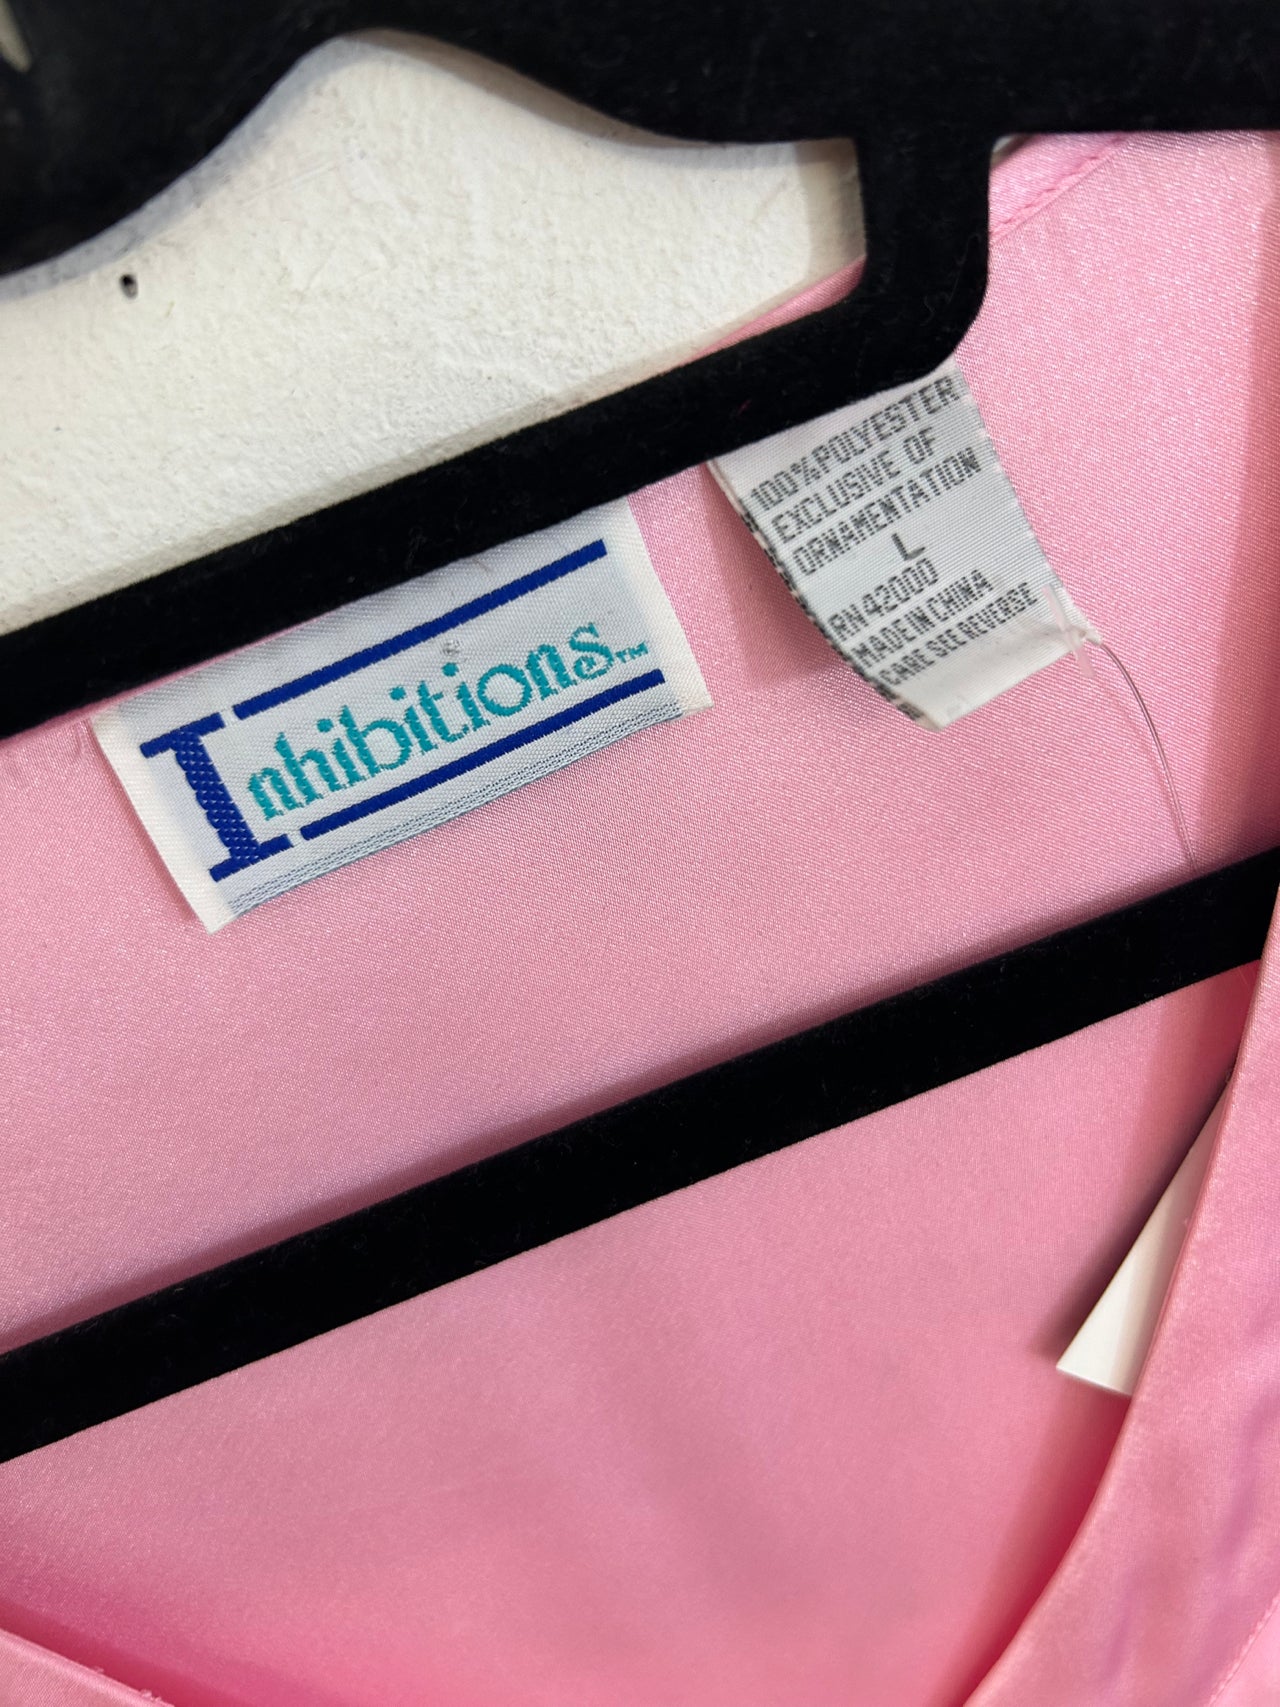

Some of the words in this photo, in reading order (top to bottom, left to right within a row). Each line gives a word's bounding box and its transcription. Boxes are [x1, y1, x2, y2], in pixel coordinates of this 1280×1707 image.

[771, 450, 901, 544] EXCLUSIVE
[902, 426, 936, 465] OF
[792, 447, 982, 576] ORNAMENTATION
[891, 532, 926, 562] L
[828, 603, 869, 642] RN
[861, 557, 939, 617] 42000
[851, 618, 916, 669] MADE
[904, 606, 936, 635] IN
[926, 569, 994, 622] CHINA
[878, 648, 935, 685] CARE
[925, 629, 967, 659] SEE
[956, 582, 1038, 640] REVERSE
